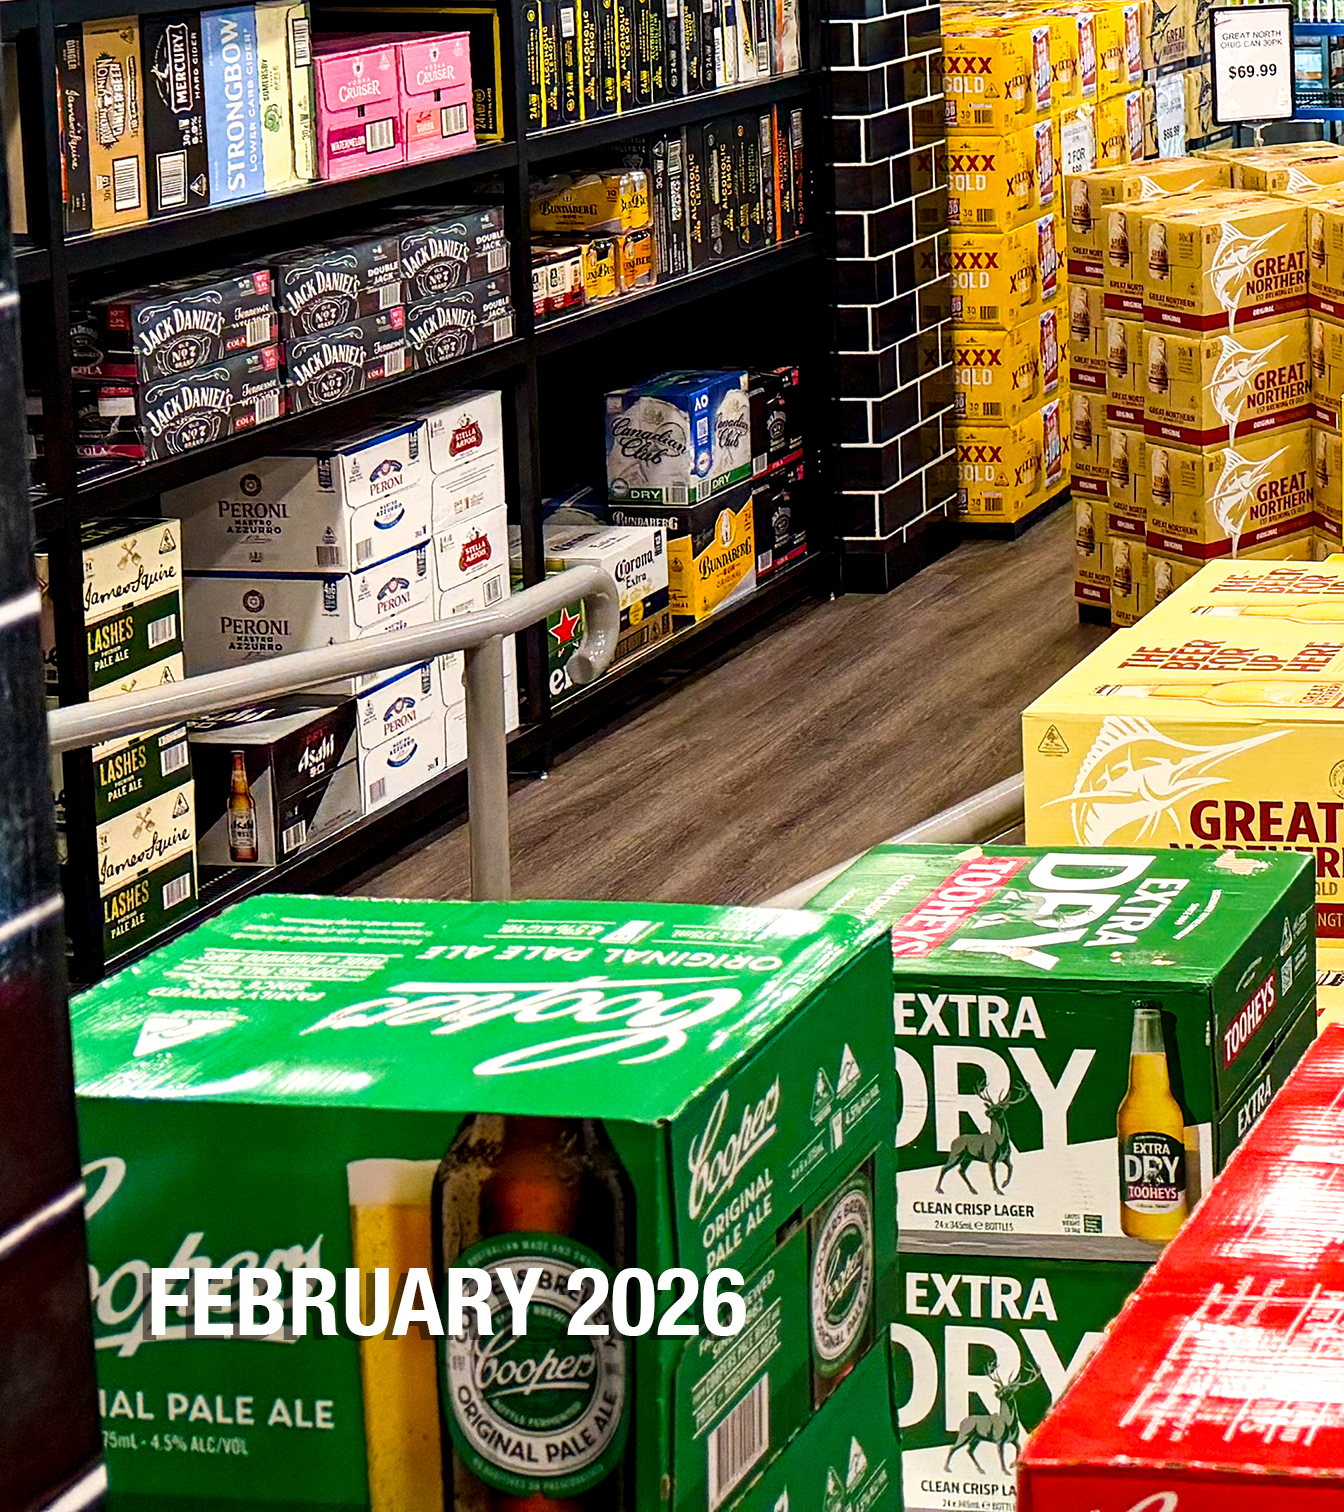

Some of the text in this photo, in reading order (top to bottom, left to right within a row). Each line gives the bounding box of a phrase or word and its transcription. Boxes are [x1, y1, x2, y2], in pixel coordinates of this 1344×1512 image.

[1222, 30, 1282, 41] GREAT NORTH
[1244, 39, 1261, 48] CAN
[417, 65, 455, 86] CRUISER
[1228, 64, 1277, 80] $69.99
[339, 80, 381, 103] CRUISER
[219, 18, 246, 192] STRONGBOW
[539, 202, 598, 216] BUNDABERG
[476, 229, 504, 246] DOUBLE
[368, 261, 399, 277] DOUBLE
[1253, 251, 1306, 278] GREAT
[1246, 269, 1310, 296] NORTHERN
[139, 302, 226, 357] JACK DANIEL'S
[227, 336, 246, 349] COLA
[236, 415, 255, 427] COLA
[611, 417, 688, 455] Canadian
[620, 438, 669, 465] Club
[369, 476, 403, 496] PERONI
[712, 472, 731, 488] DRY
[630, 490, 661, 500] DRY
[218, 500, 289, 520] PERONI
[227, 525, 282, 534] AZZURRO
[699, 537, 753, 580] BUNDABERG
[625, 574, 647, 590] Extra
[87, 616, 134, 656] LASHES
[220, 617, 291, 636] PERONI
[229, 643, 283, 651] AZZURRO
[95, 649, 130, 672] PALE ALE
[298, 733, 335, 772] Asahi
[99, 746, 147, 786] LASHES
[1188, 801, 1344, 843] GREAT
[1084, 878, 1189, 948] EXTRA
[416, 945, 783, 971] ORIGINAL PALE ALE
[894, 994, 1046, 1039] EXTRA
[1224, 974, 1275, 1061] TOOHEYS
[688, 1074, 779, 1220] Coopers
[1132, 1142, 1171, 1156] EXTRA
[703, 1168, 773, 1248] ORIGINAL
[913, 1200, 1035, 1218] CLEAN CRISP LAGER
[906, 1272, 1058, 1321] EXTRA
[167, 1391, 254, 1425] PALE
[268, 1399, 335, 1429] ALE
[151, 1434, 248, 1456] 4.5% ALC/VOL
